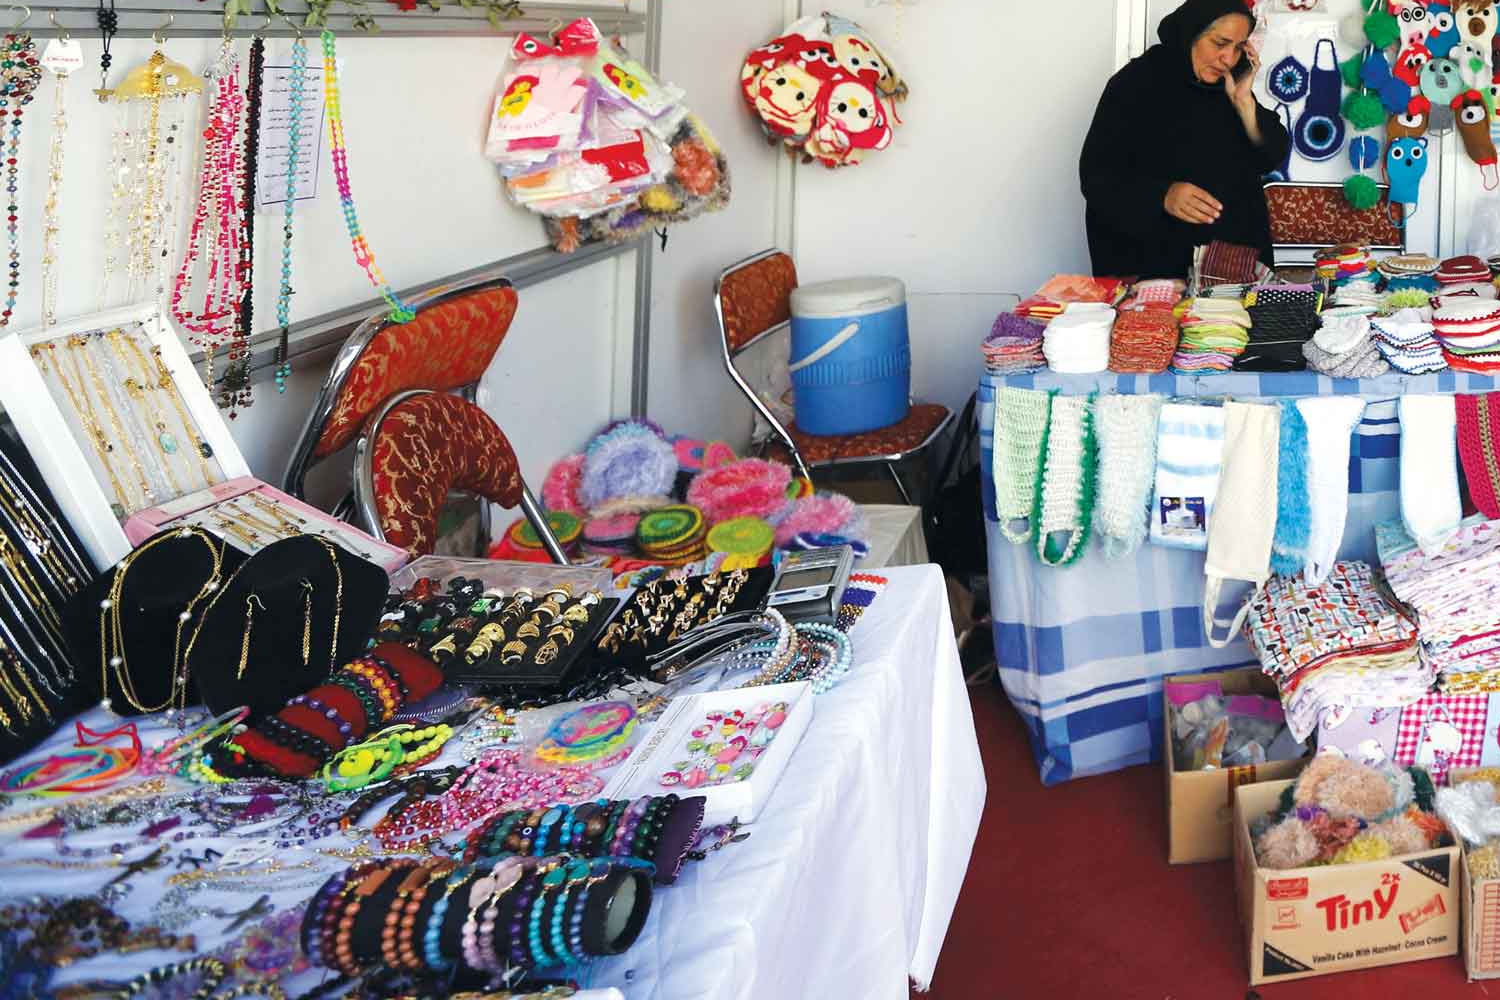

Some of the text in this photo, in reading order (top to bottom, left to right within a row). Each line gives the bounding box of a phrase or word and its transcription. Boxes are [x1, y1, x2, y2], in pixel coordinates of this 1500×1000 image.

[1316, 883, 1399, 932] Tiny
[1312, 951, 1336, 964] Vanilla
[1355, 945, 1371, 958] With
[1372, 943, 1401, 956] Hazelnut
[1426, 935, 1448, 946] Cream
